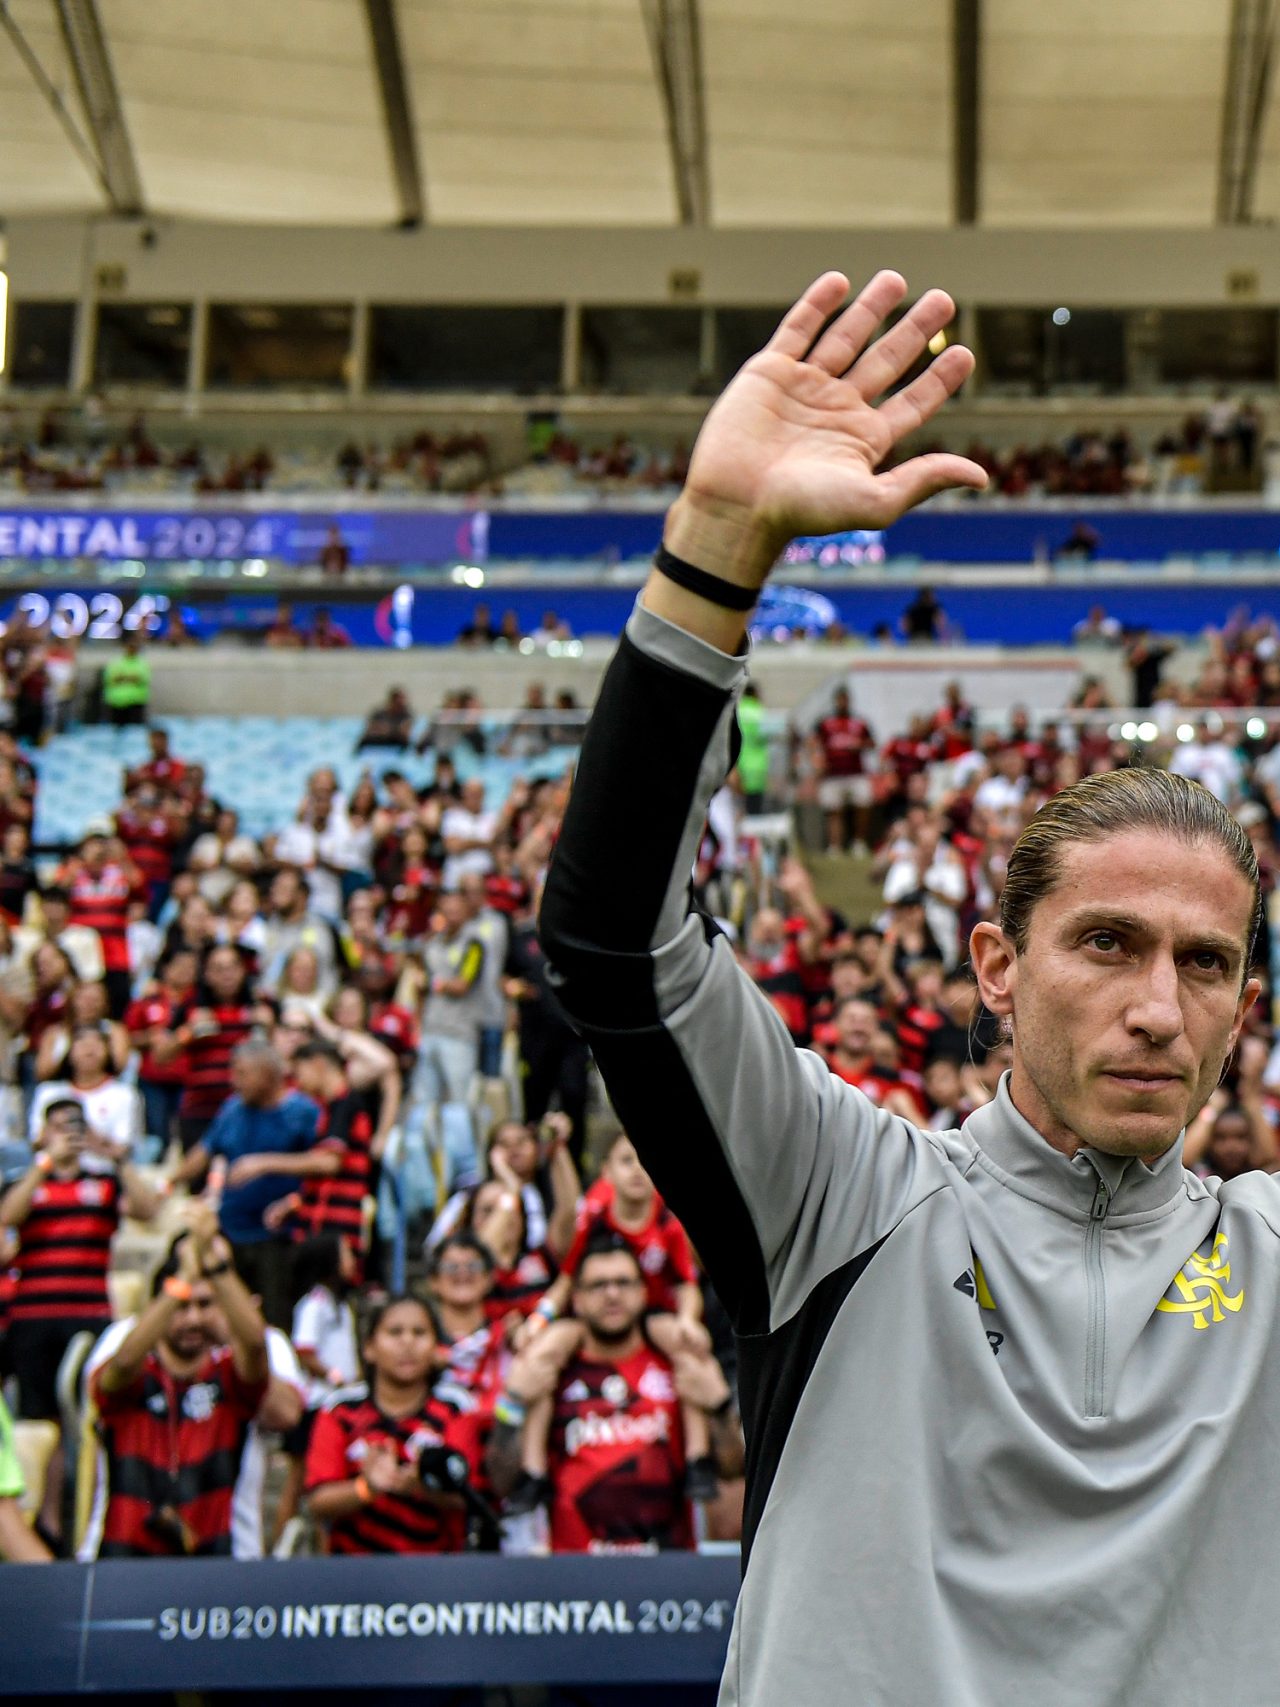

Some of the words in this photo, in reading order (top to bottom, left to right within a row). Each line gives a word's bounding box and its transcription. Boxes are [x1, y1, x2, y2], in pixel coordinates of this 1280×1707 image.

[159, 1606, 277, 1640] SUB20
[281, 1601, 633, 1638] INTERCONTINENTAL
[637, 1600, 724, 1633] 2024
